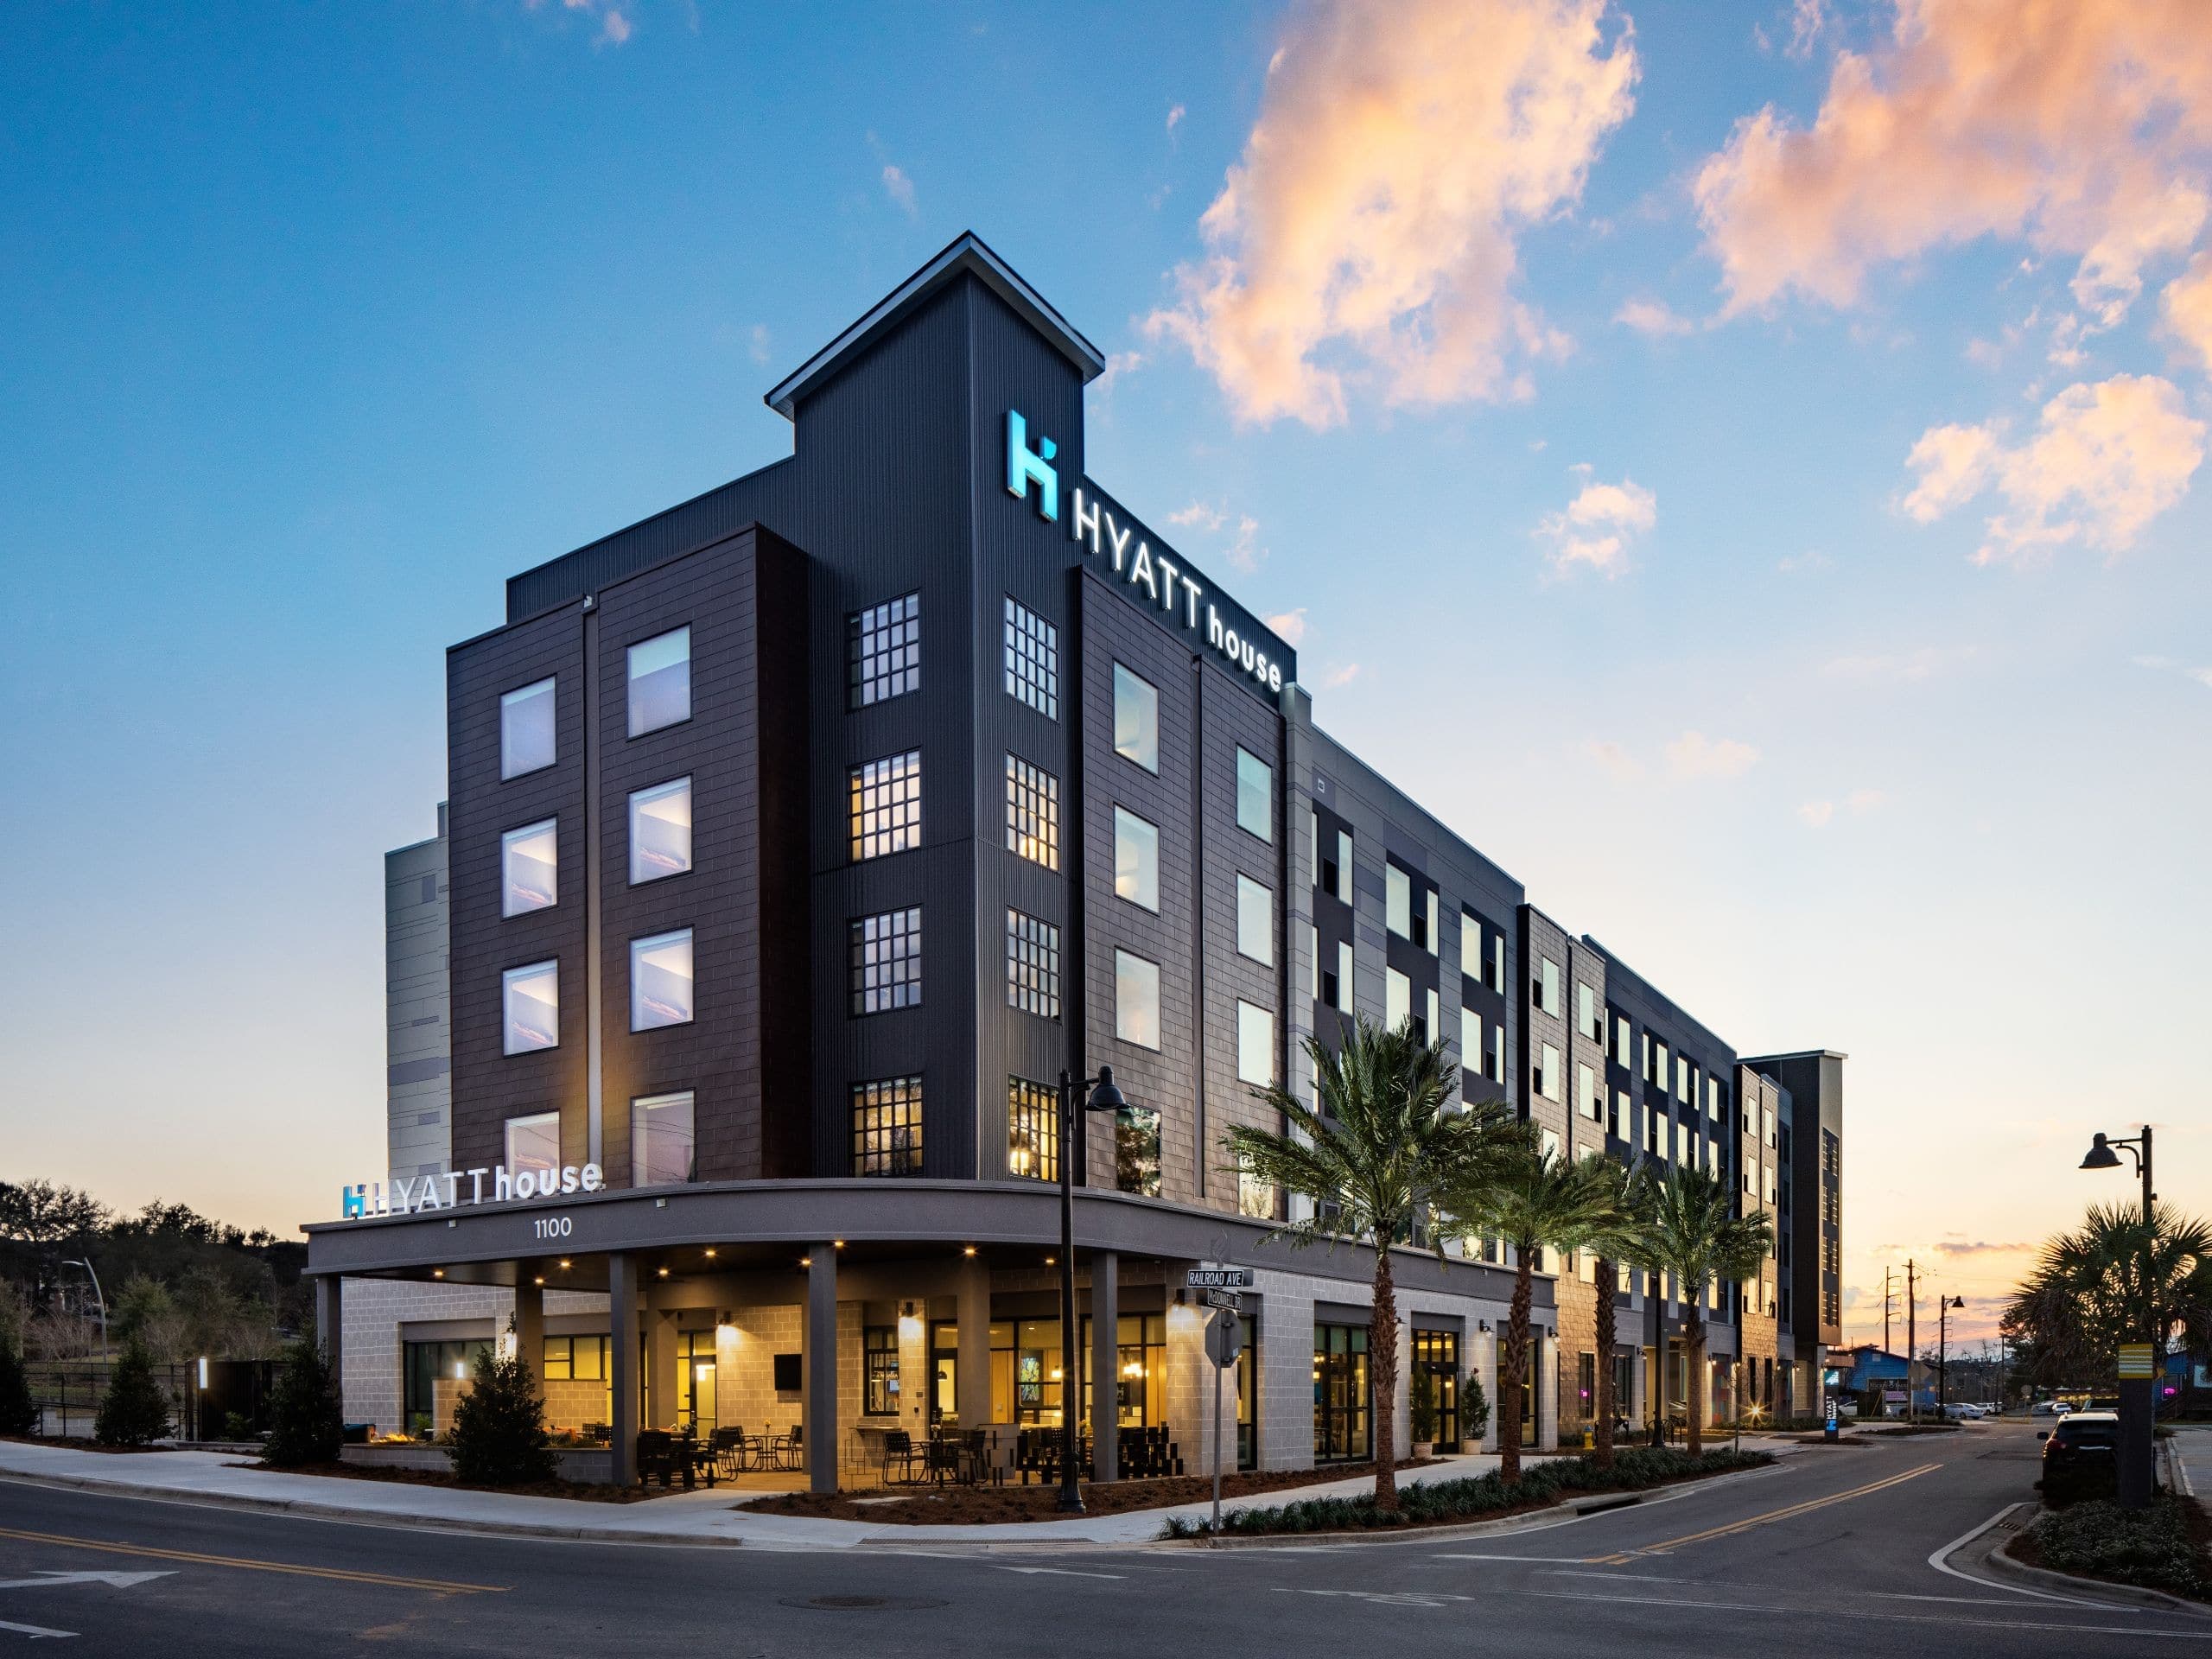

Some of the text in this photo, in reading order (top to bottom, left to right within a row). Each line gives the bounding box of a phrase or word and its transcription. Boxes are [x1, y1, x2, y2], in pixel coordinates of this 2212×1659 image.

[1071, 487, 1281, 692] HYATT house
[372, 1163, 603, 1217] HYATT house
[534, 1217, 572, 1239] 1100
[1189, 1272, 1242, 1285] RAILROAD AVE
